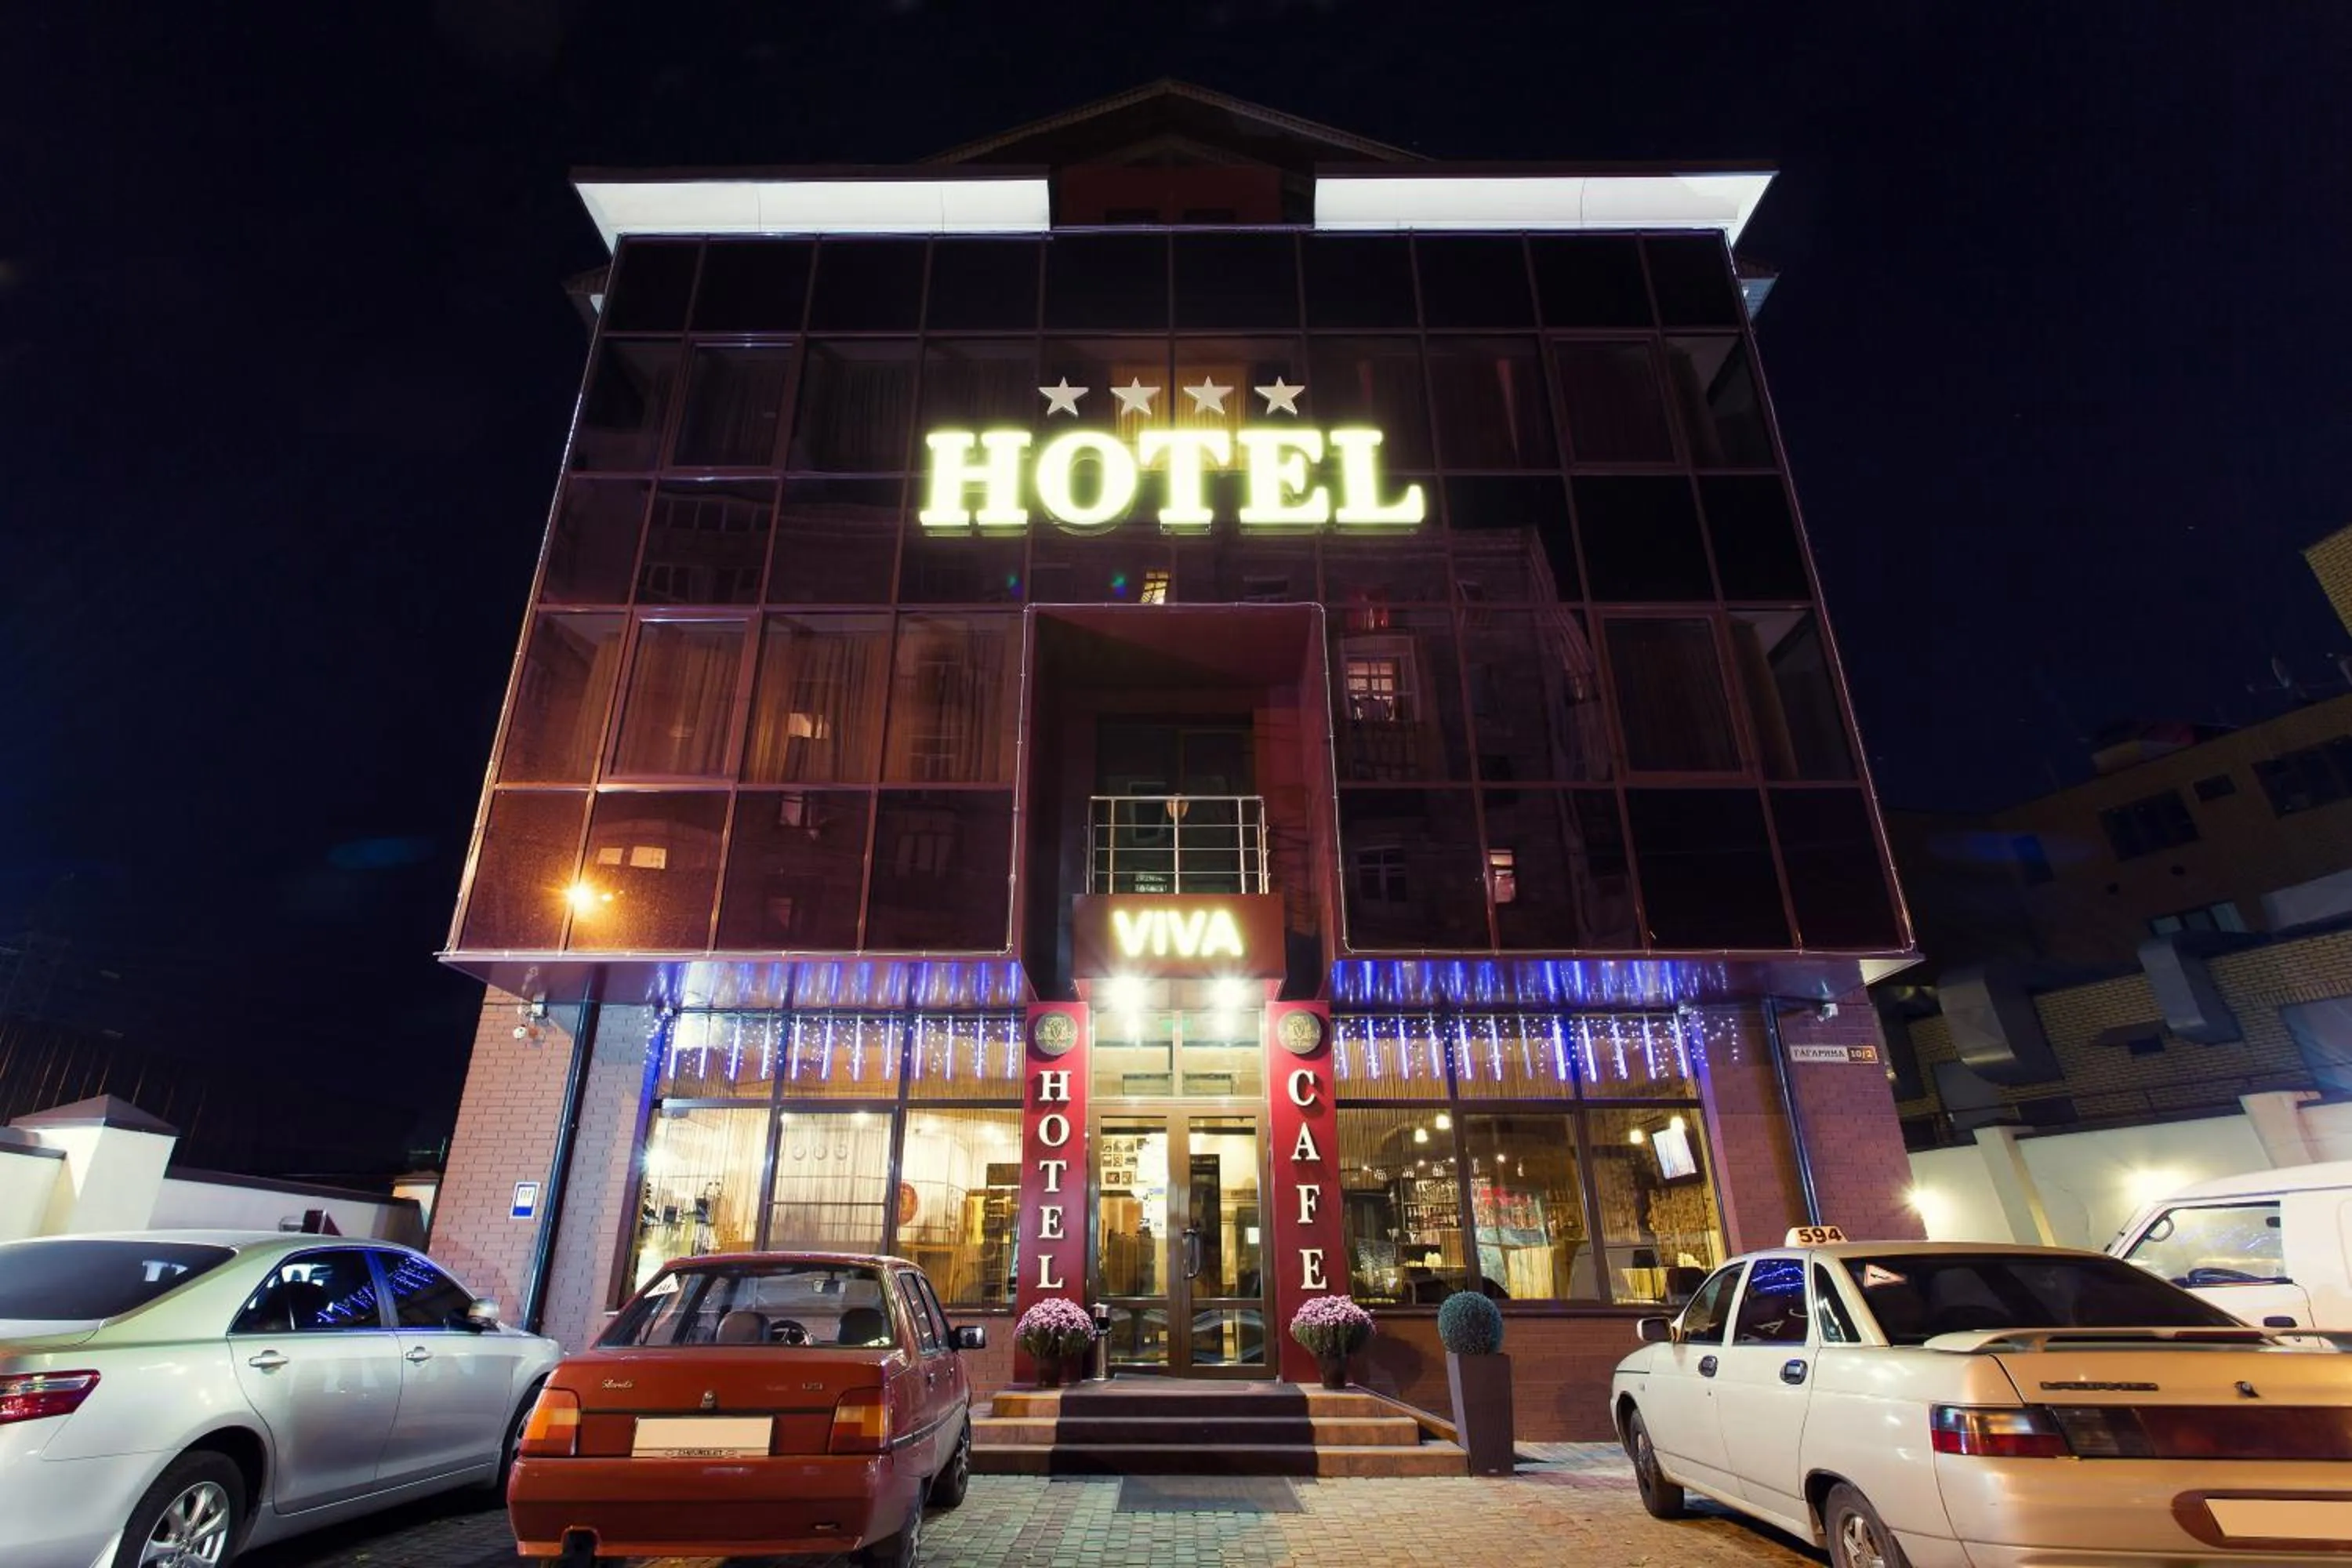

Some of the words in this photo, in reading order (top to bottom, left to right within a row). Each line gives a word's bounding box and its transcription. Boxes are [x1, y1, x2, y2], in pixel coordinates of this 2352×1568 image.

[920, 428, 1425, 528] HOTEL
[1112, 909, 1244, 957] VIVA
[1036, 1069, 1072, 1290] HOTEL
[1287, 1069, 1328, 1290] CAFE
[1798, 1228, 1842, 1243] 594
